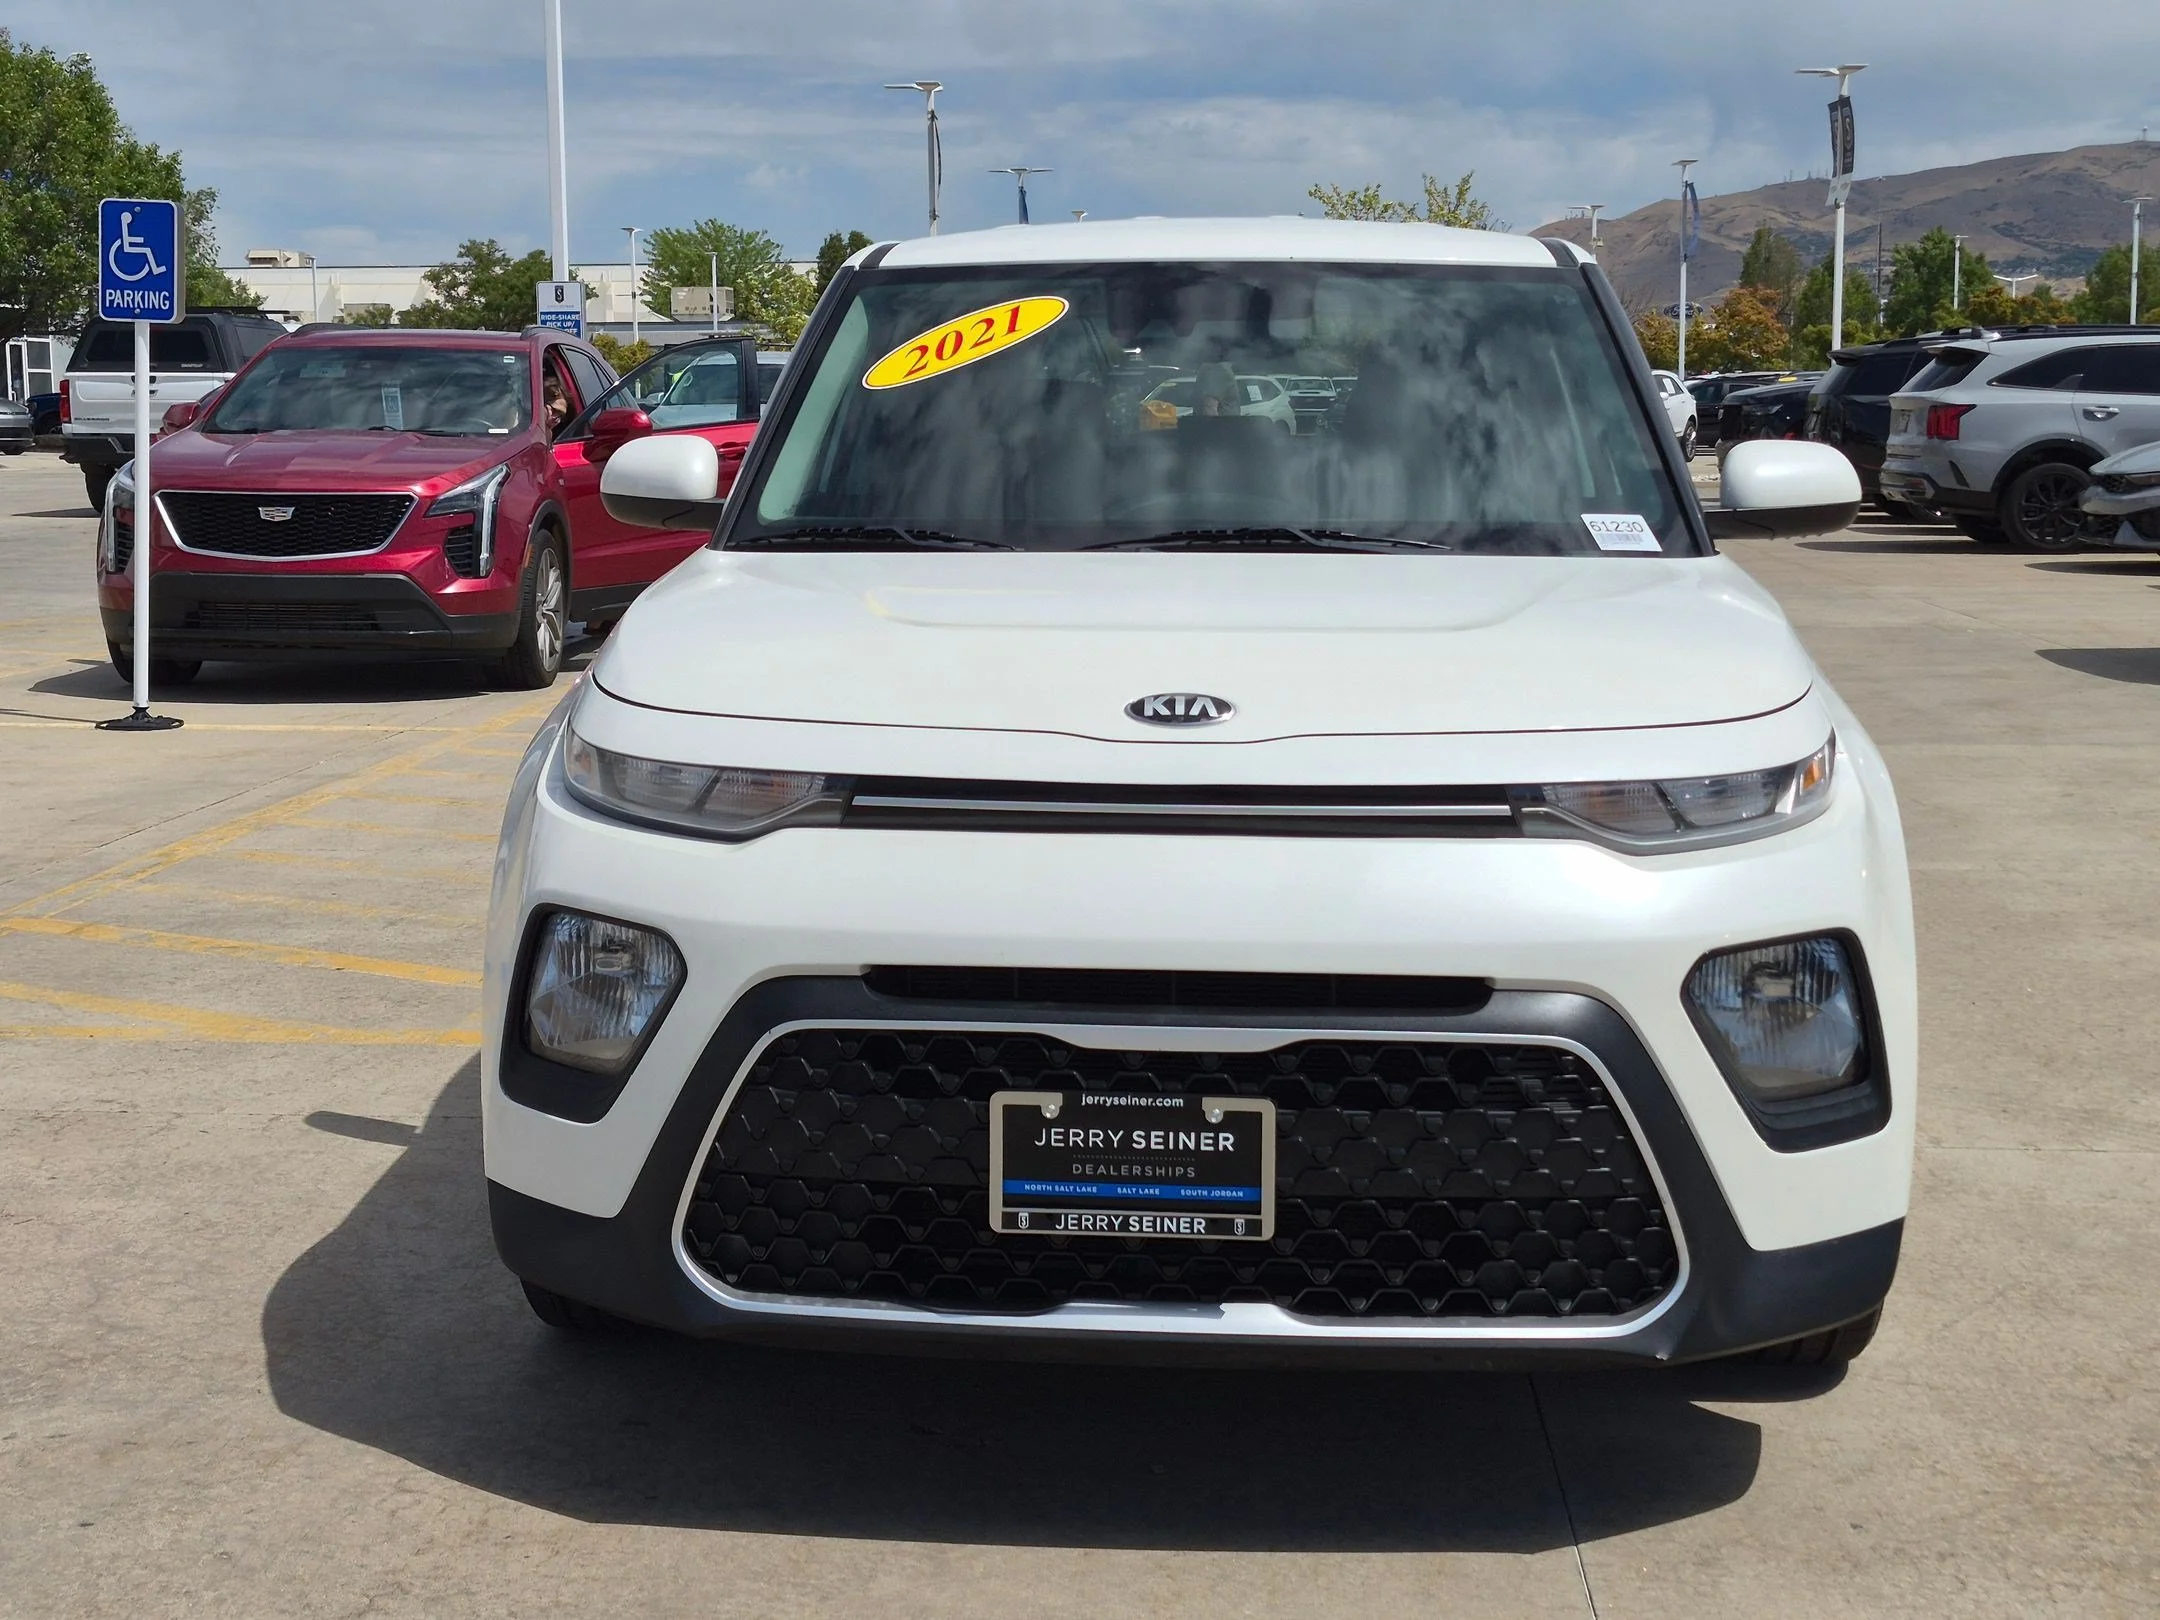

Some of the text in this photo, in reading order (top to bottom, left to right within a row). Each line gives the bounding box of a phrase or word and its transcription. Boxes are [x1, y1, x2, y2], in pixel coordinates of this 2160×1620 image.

[105, 289, 170, 310] PARKING
[903, 305, 1024, 379] 2021
[1589, 521, 1644, 533] 61230
[1144, 695, 1219, 717] KIA
[1081, 1093, 1184, 1107] jerryseiner.com
[1034, 1128, 1235, 1152] JERRY SEINER
[1072, 1163, 1196, 1178] DEALERSHIPS
[1024, 1183, 1097, 1193] NORTH SALT LAKE
[1117, 1187, 1137, 1195] SALT
[1055, 1214, 1206, 1234] JERRY SEINER
